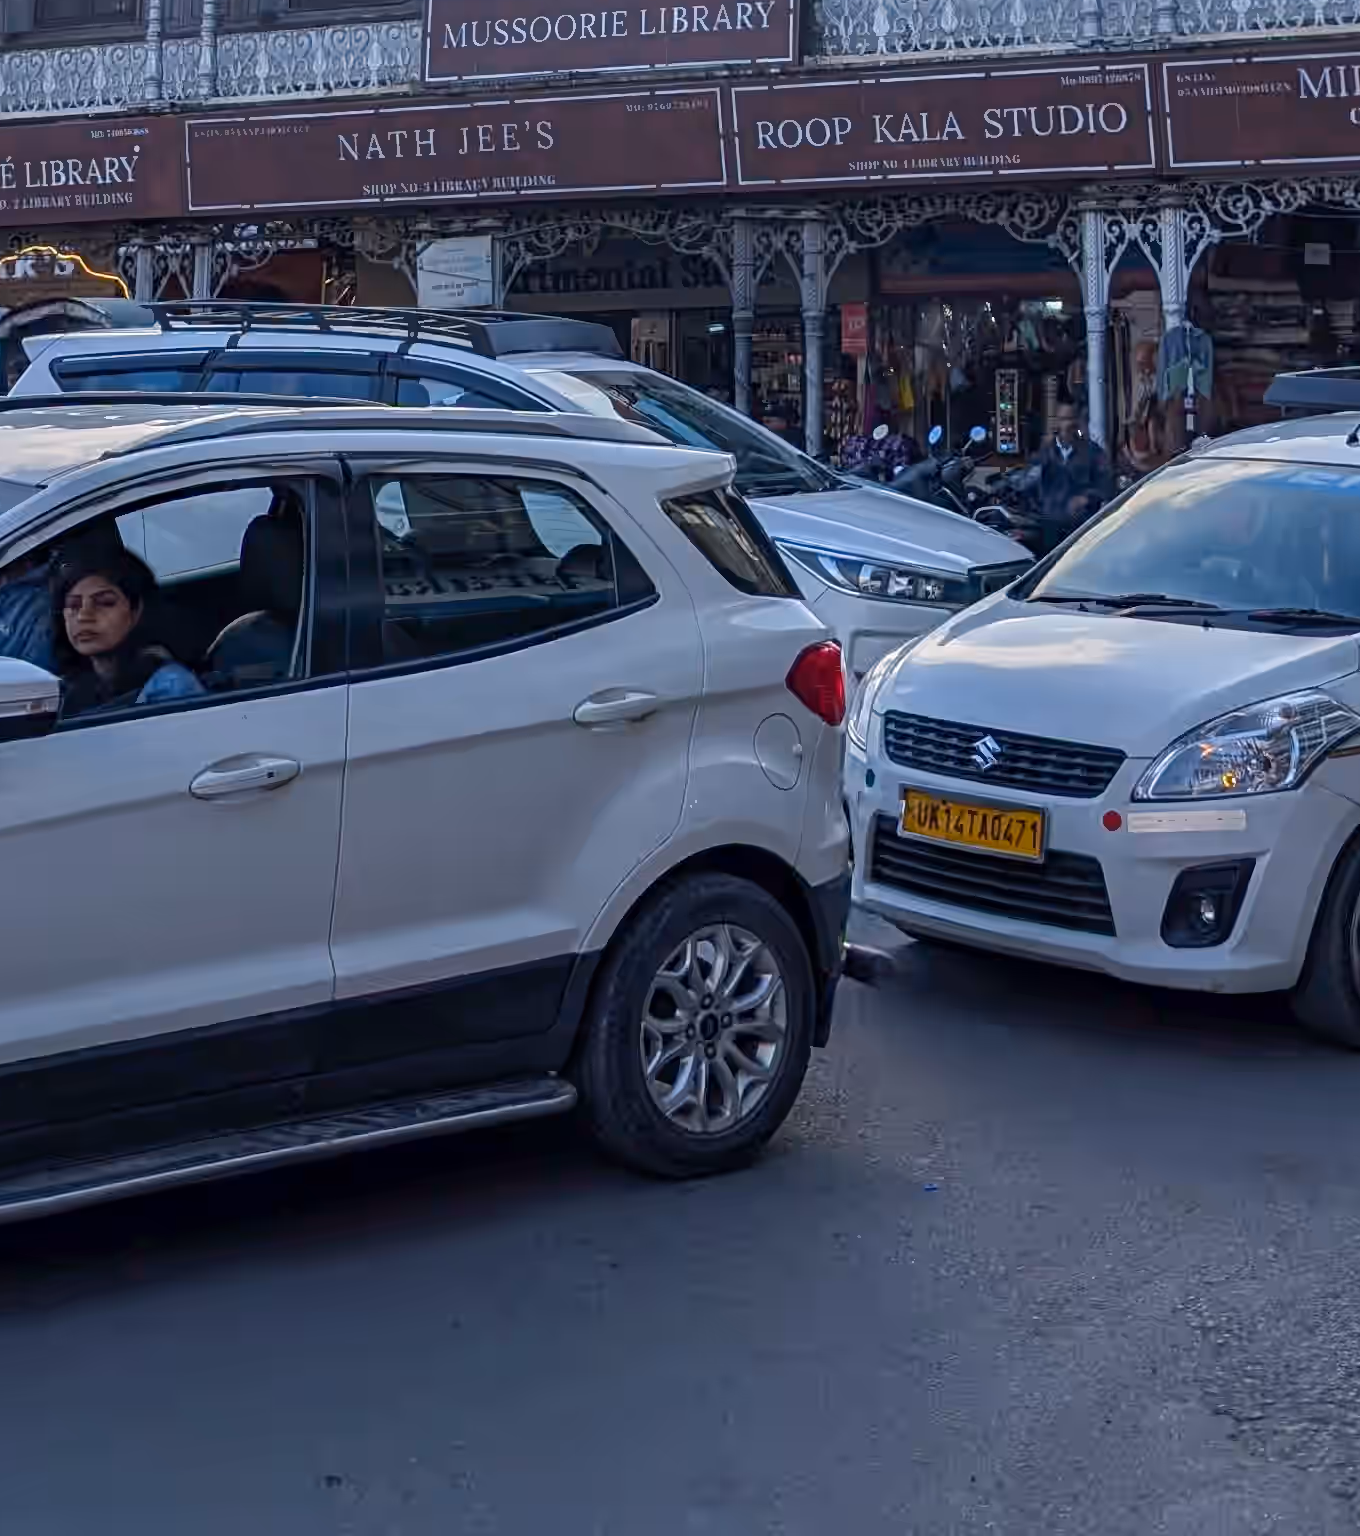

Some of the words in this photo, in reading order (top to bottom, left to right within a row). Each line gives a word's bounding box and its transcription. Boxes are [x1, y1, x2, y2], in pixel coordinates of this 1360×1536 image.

[443, 11, 628, 49] MUSSOORIE
[640, 0, 776, 36] LIBRARY
[338, 129, 436, 161] NATH
[459, 121, 554, 154] JEE'S
[756, 116, 852, 150] ROOP
[872, 111, 965, 144] KALA
[984, 102, 1127, 139] STUDIO
[24, 156, 138, 188] LIBRARY
[75, 192, 134, 208] BUILDING
[915, 800, 1038, 850] UK14TA0471
